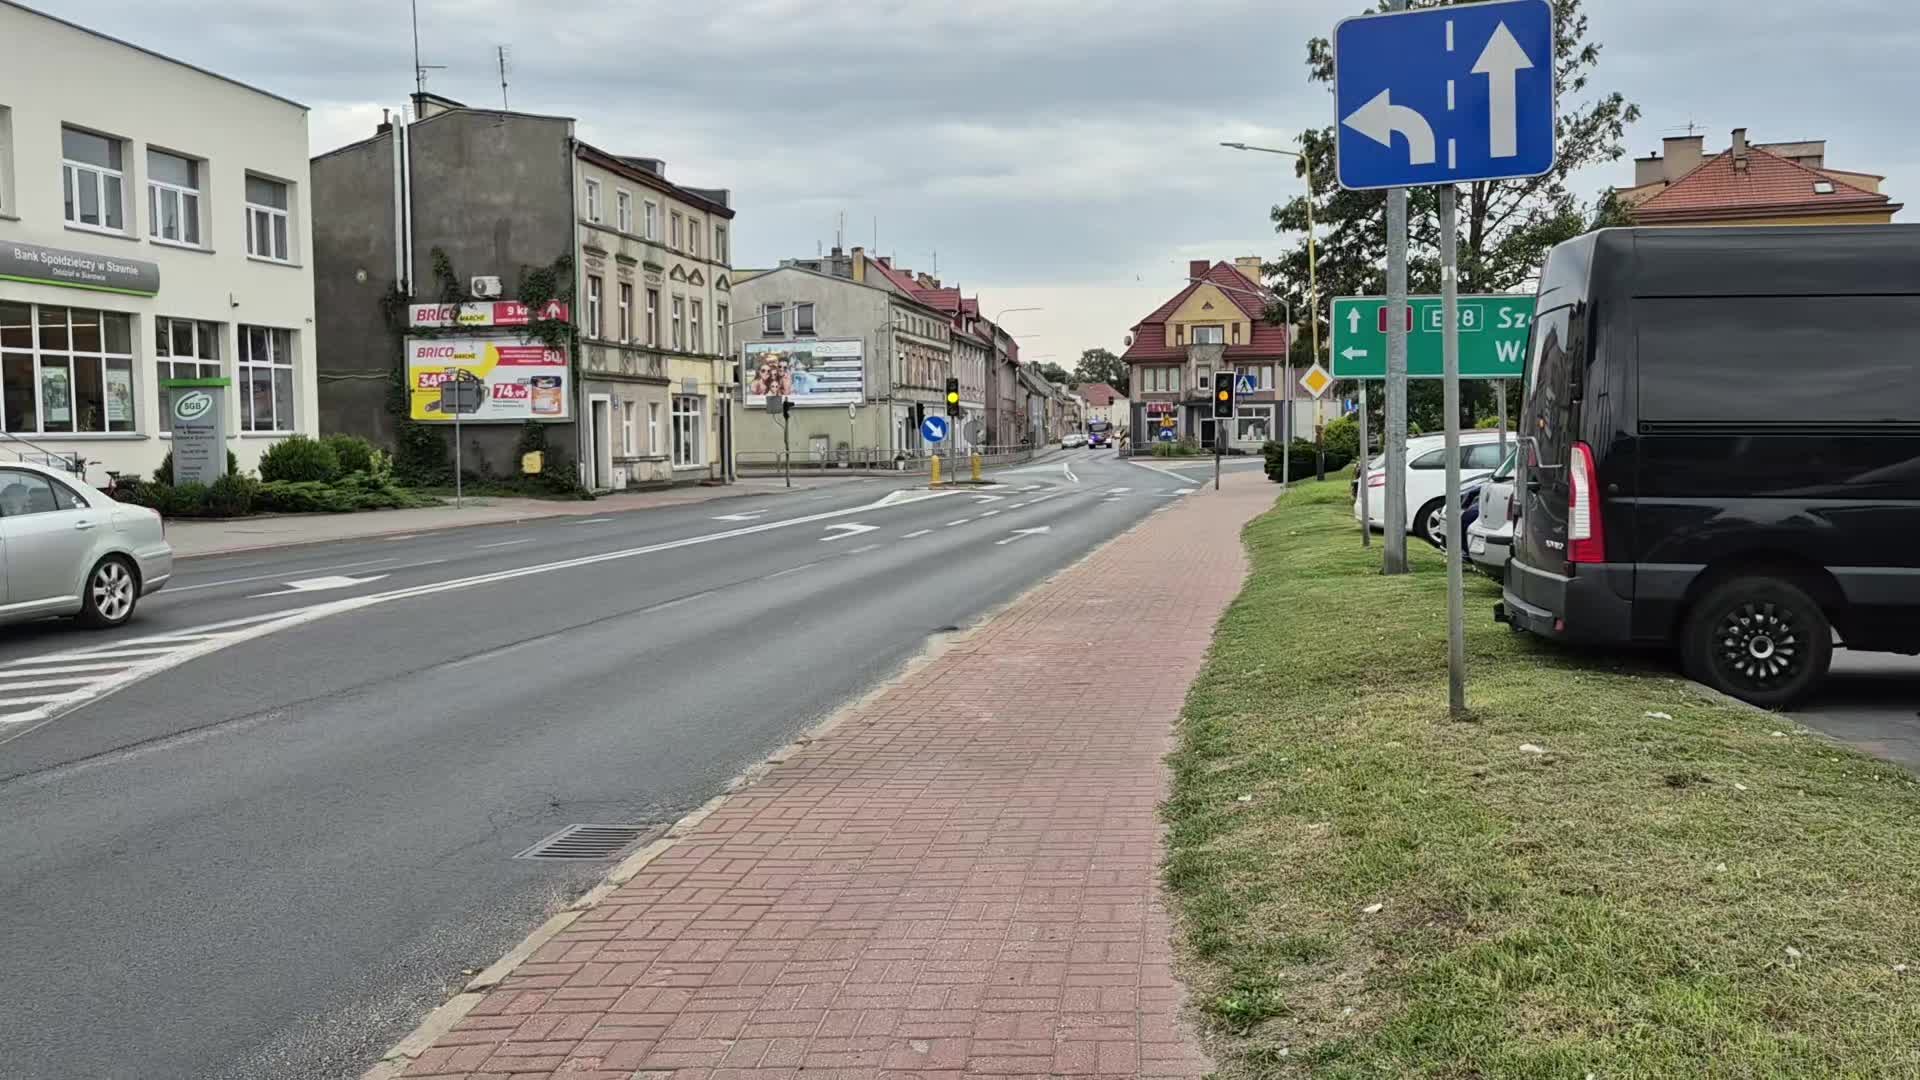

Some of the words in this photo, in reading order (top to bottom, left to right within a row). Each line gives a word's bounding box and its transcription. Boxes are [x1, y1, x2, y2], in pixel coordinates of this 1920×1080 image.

[14, 247, 39, 262] Bank
[507, 305, 515, 316] 9
[1431, 309, 1475, 327] E8
[1497, 306, 1533, 329] Sz
[417, 346, 455, 358] BRICO
[184, 402, 202, 410] SGB
